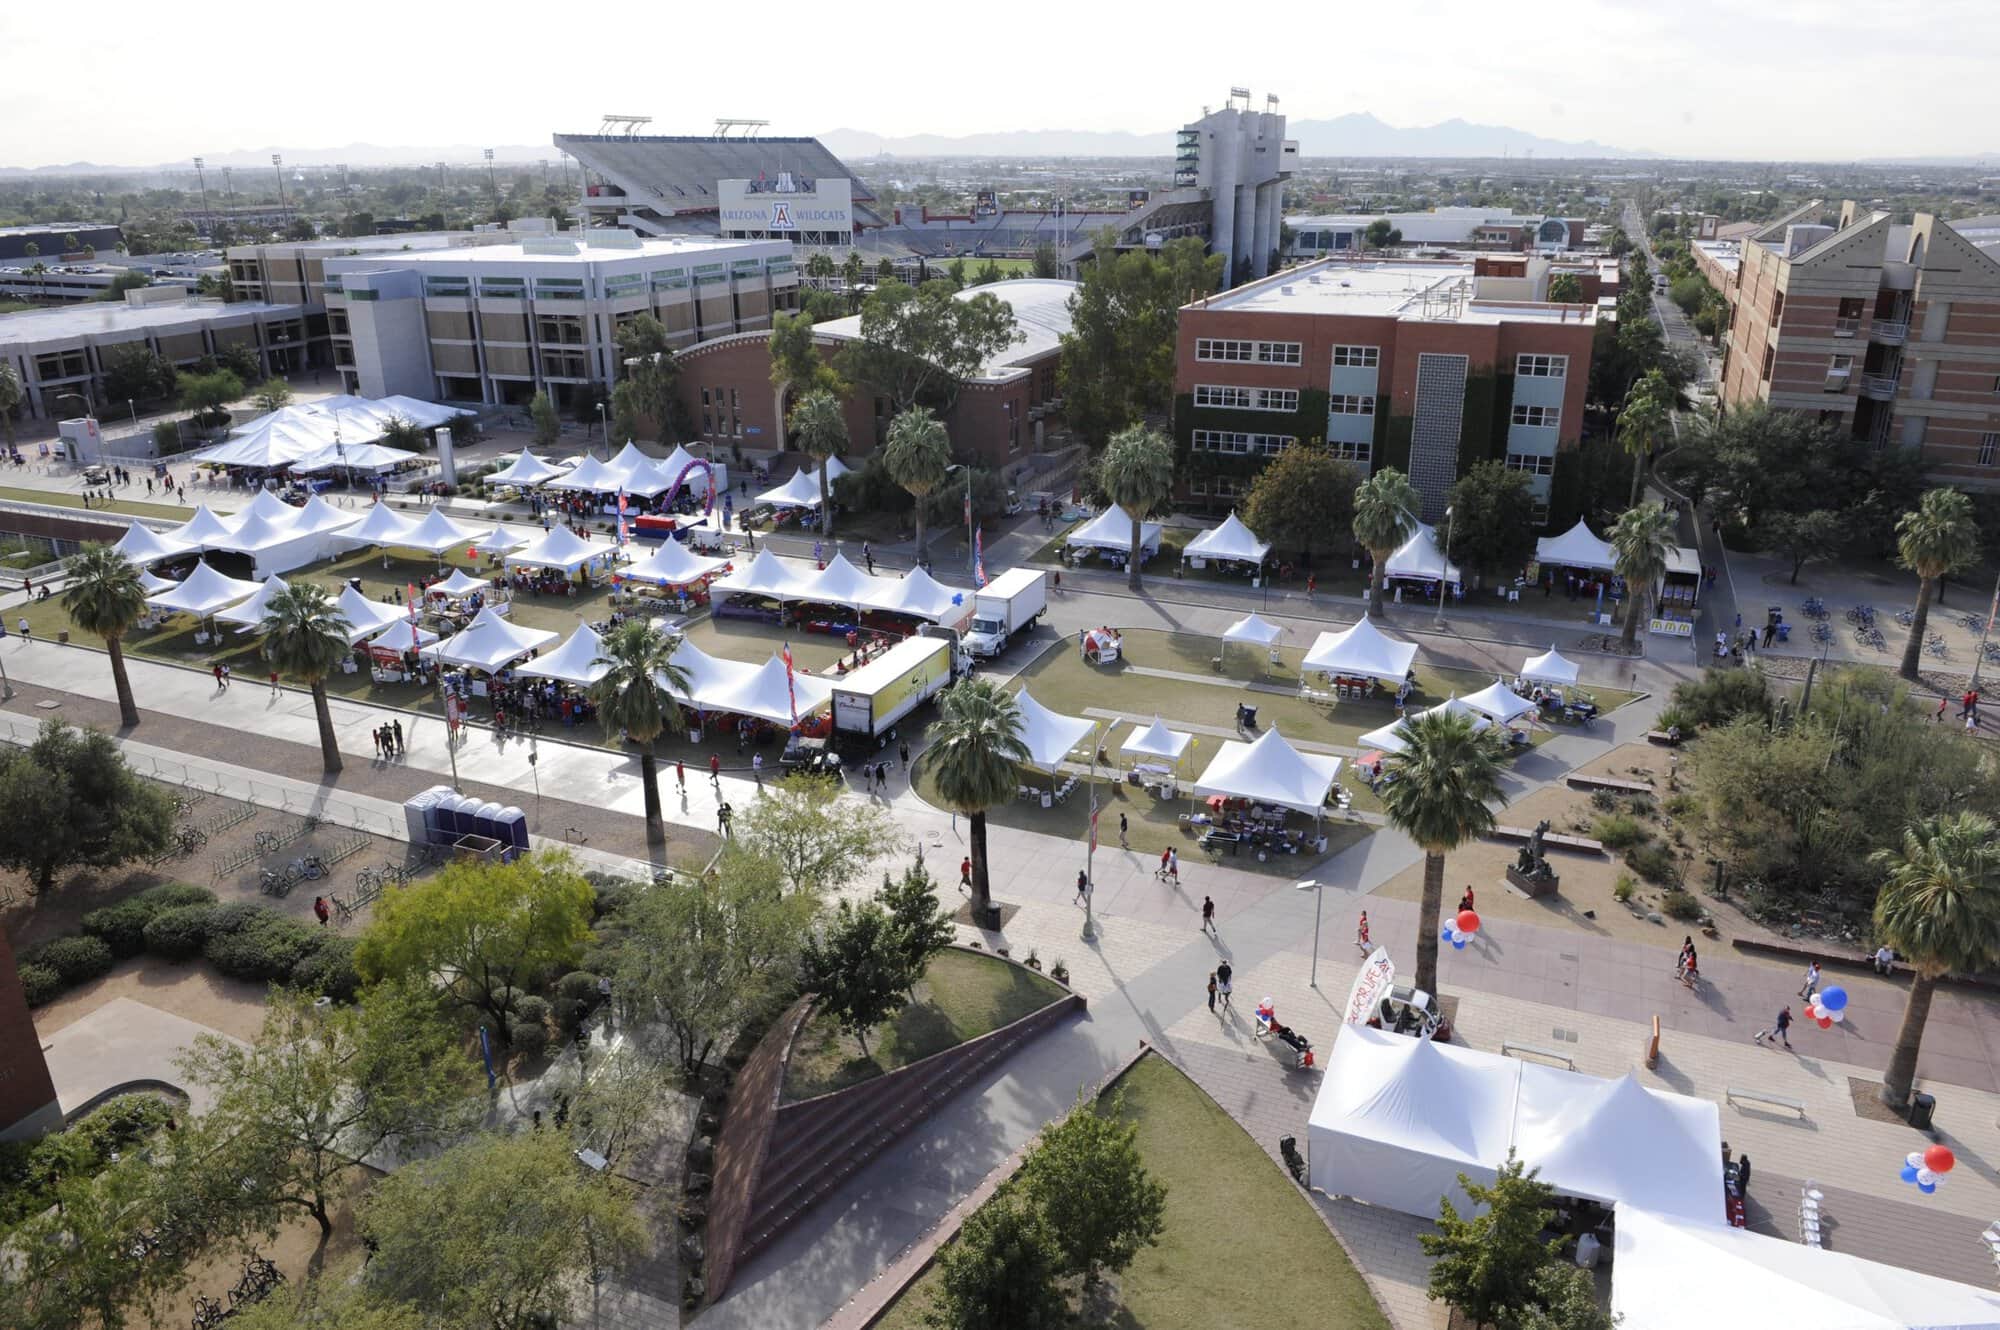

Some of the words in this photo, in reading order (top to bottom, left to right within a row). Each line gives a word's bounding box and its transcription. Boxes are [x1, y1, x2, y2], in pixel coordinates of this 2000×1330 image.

[722, 208, 767, 221] ARIZONA
[770, 203, 794, 229] A
[797, 210, 845, 221] WILDCATS
